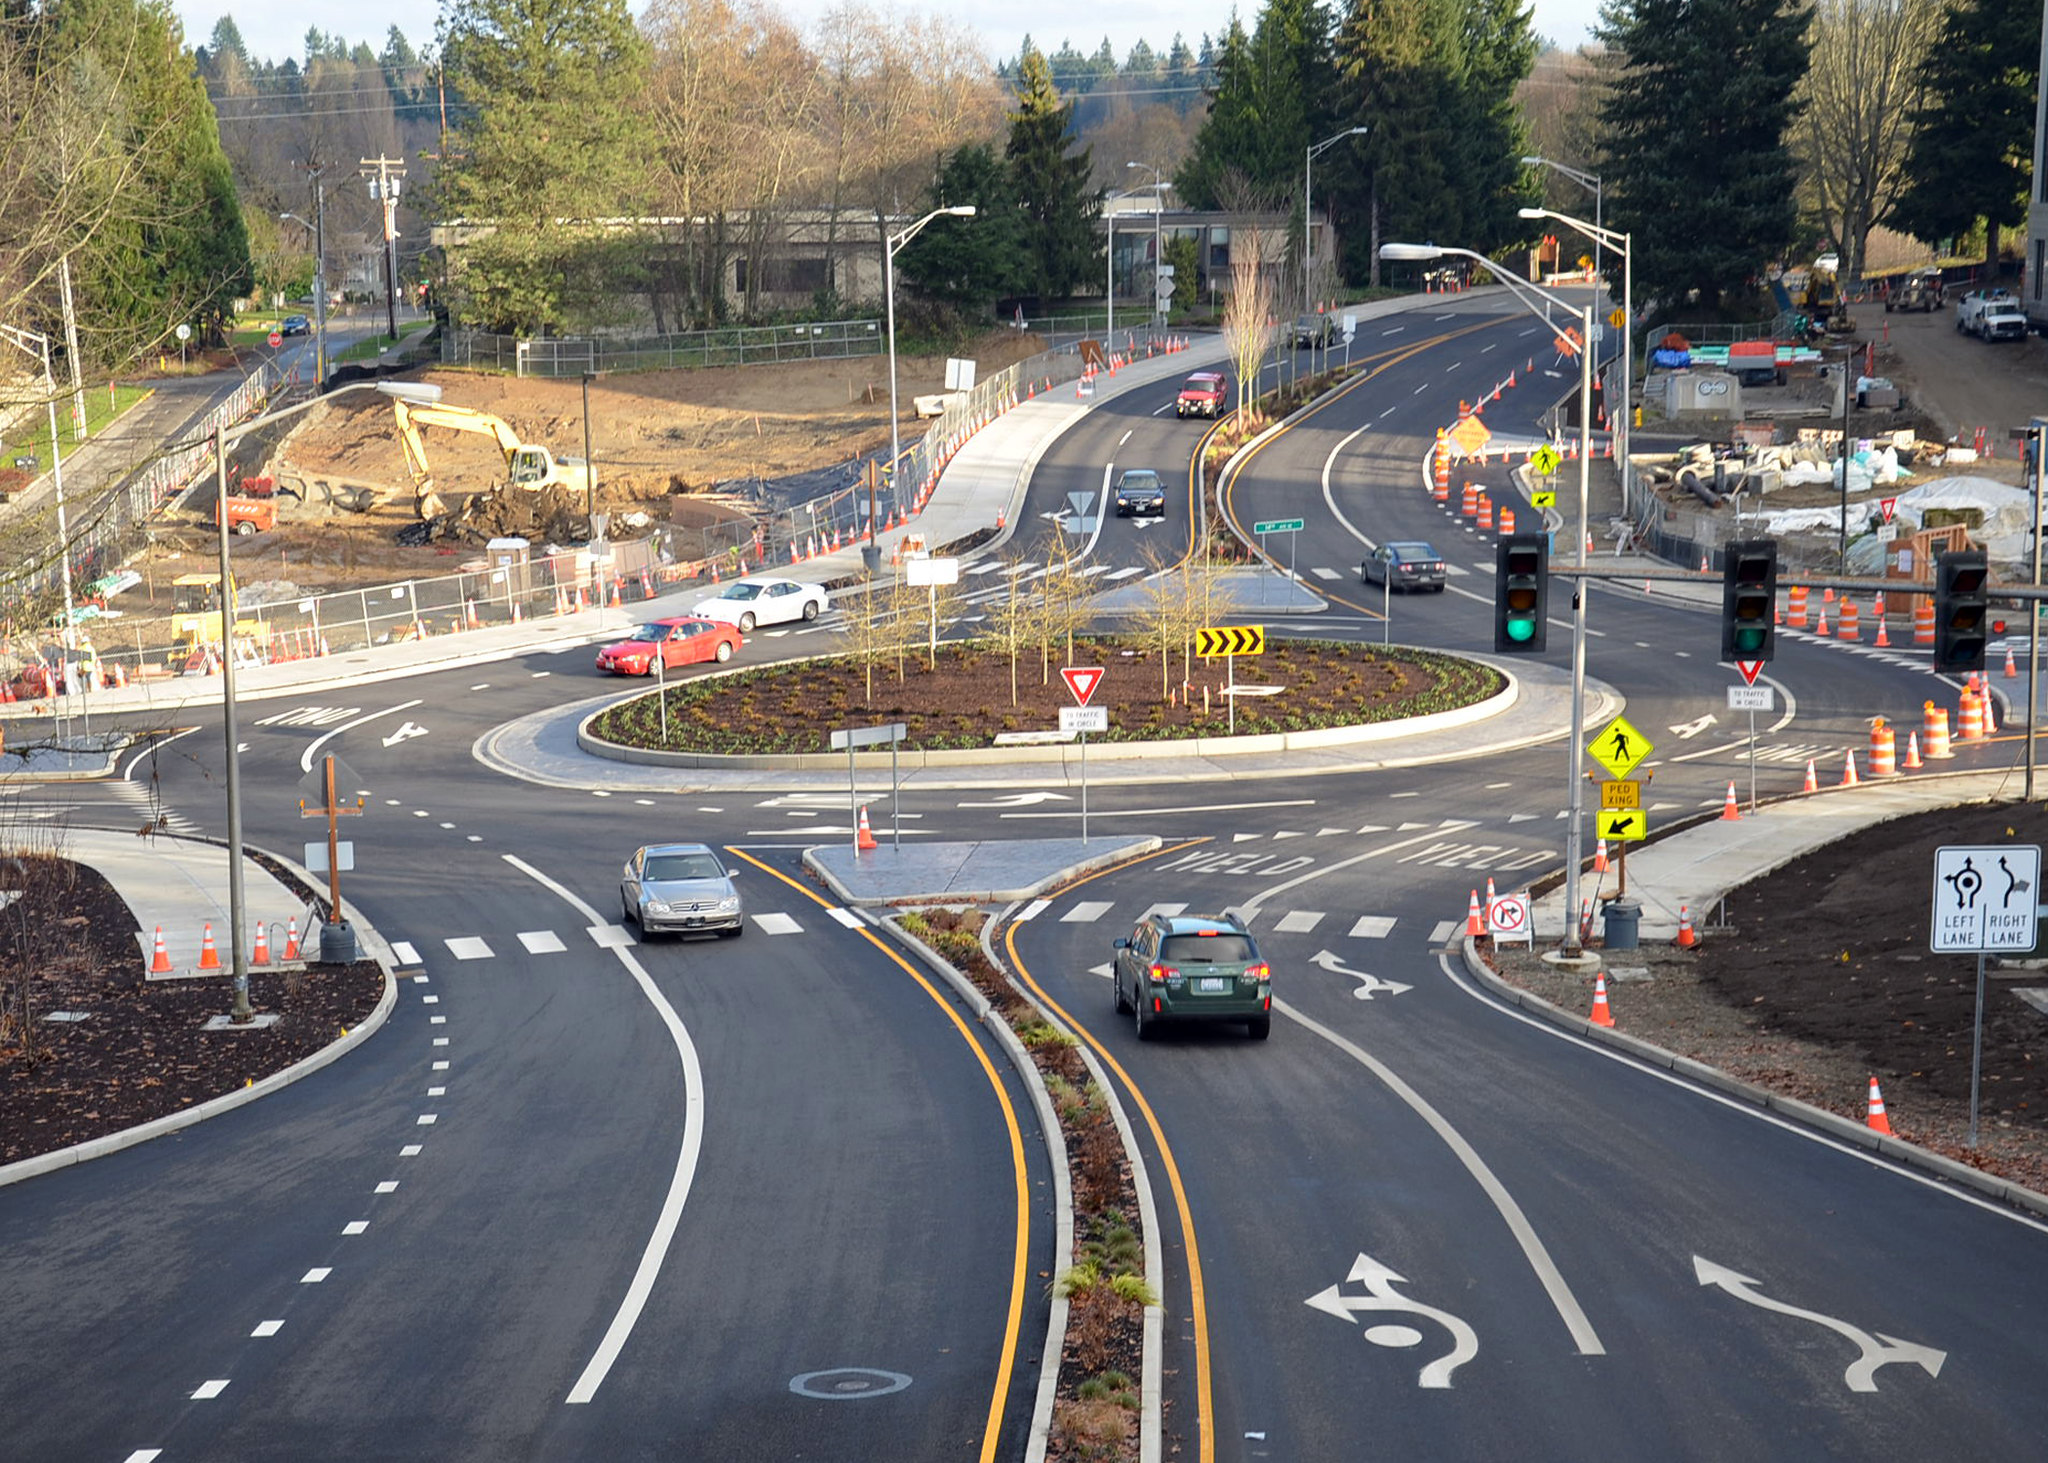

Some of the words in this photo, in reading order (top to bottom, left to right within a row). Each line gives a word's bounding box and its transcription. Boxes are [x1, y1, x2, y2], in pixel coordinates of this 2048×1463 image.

[1076, 720, 1097, 728] CIRCLE
[1610, 784, 1631, 794] PED
[1608, 795, 1633, 805] XING
[1153, 851, 1316, 876] YIELD
[1396, 842, 1558, 872] YIELD
[1944, 915, 1976, 928] LEFT
[1989, 914, 2028, 928] RIGHT
[1942, 932, 1975, 945] LANE
[1991, 931, 2024, 945] LANE
